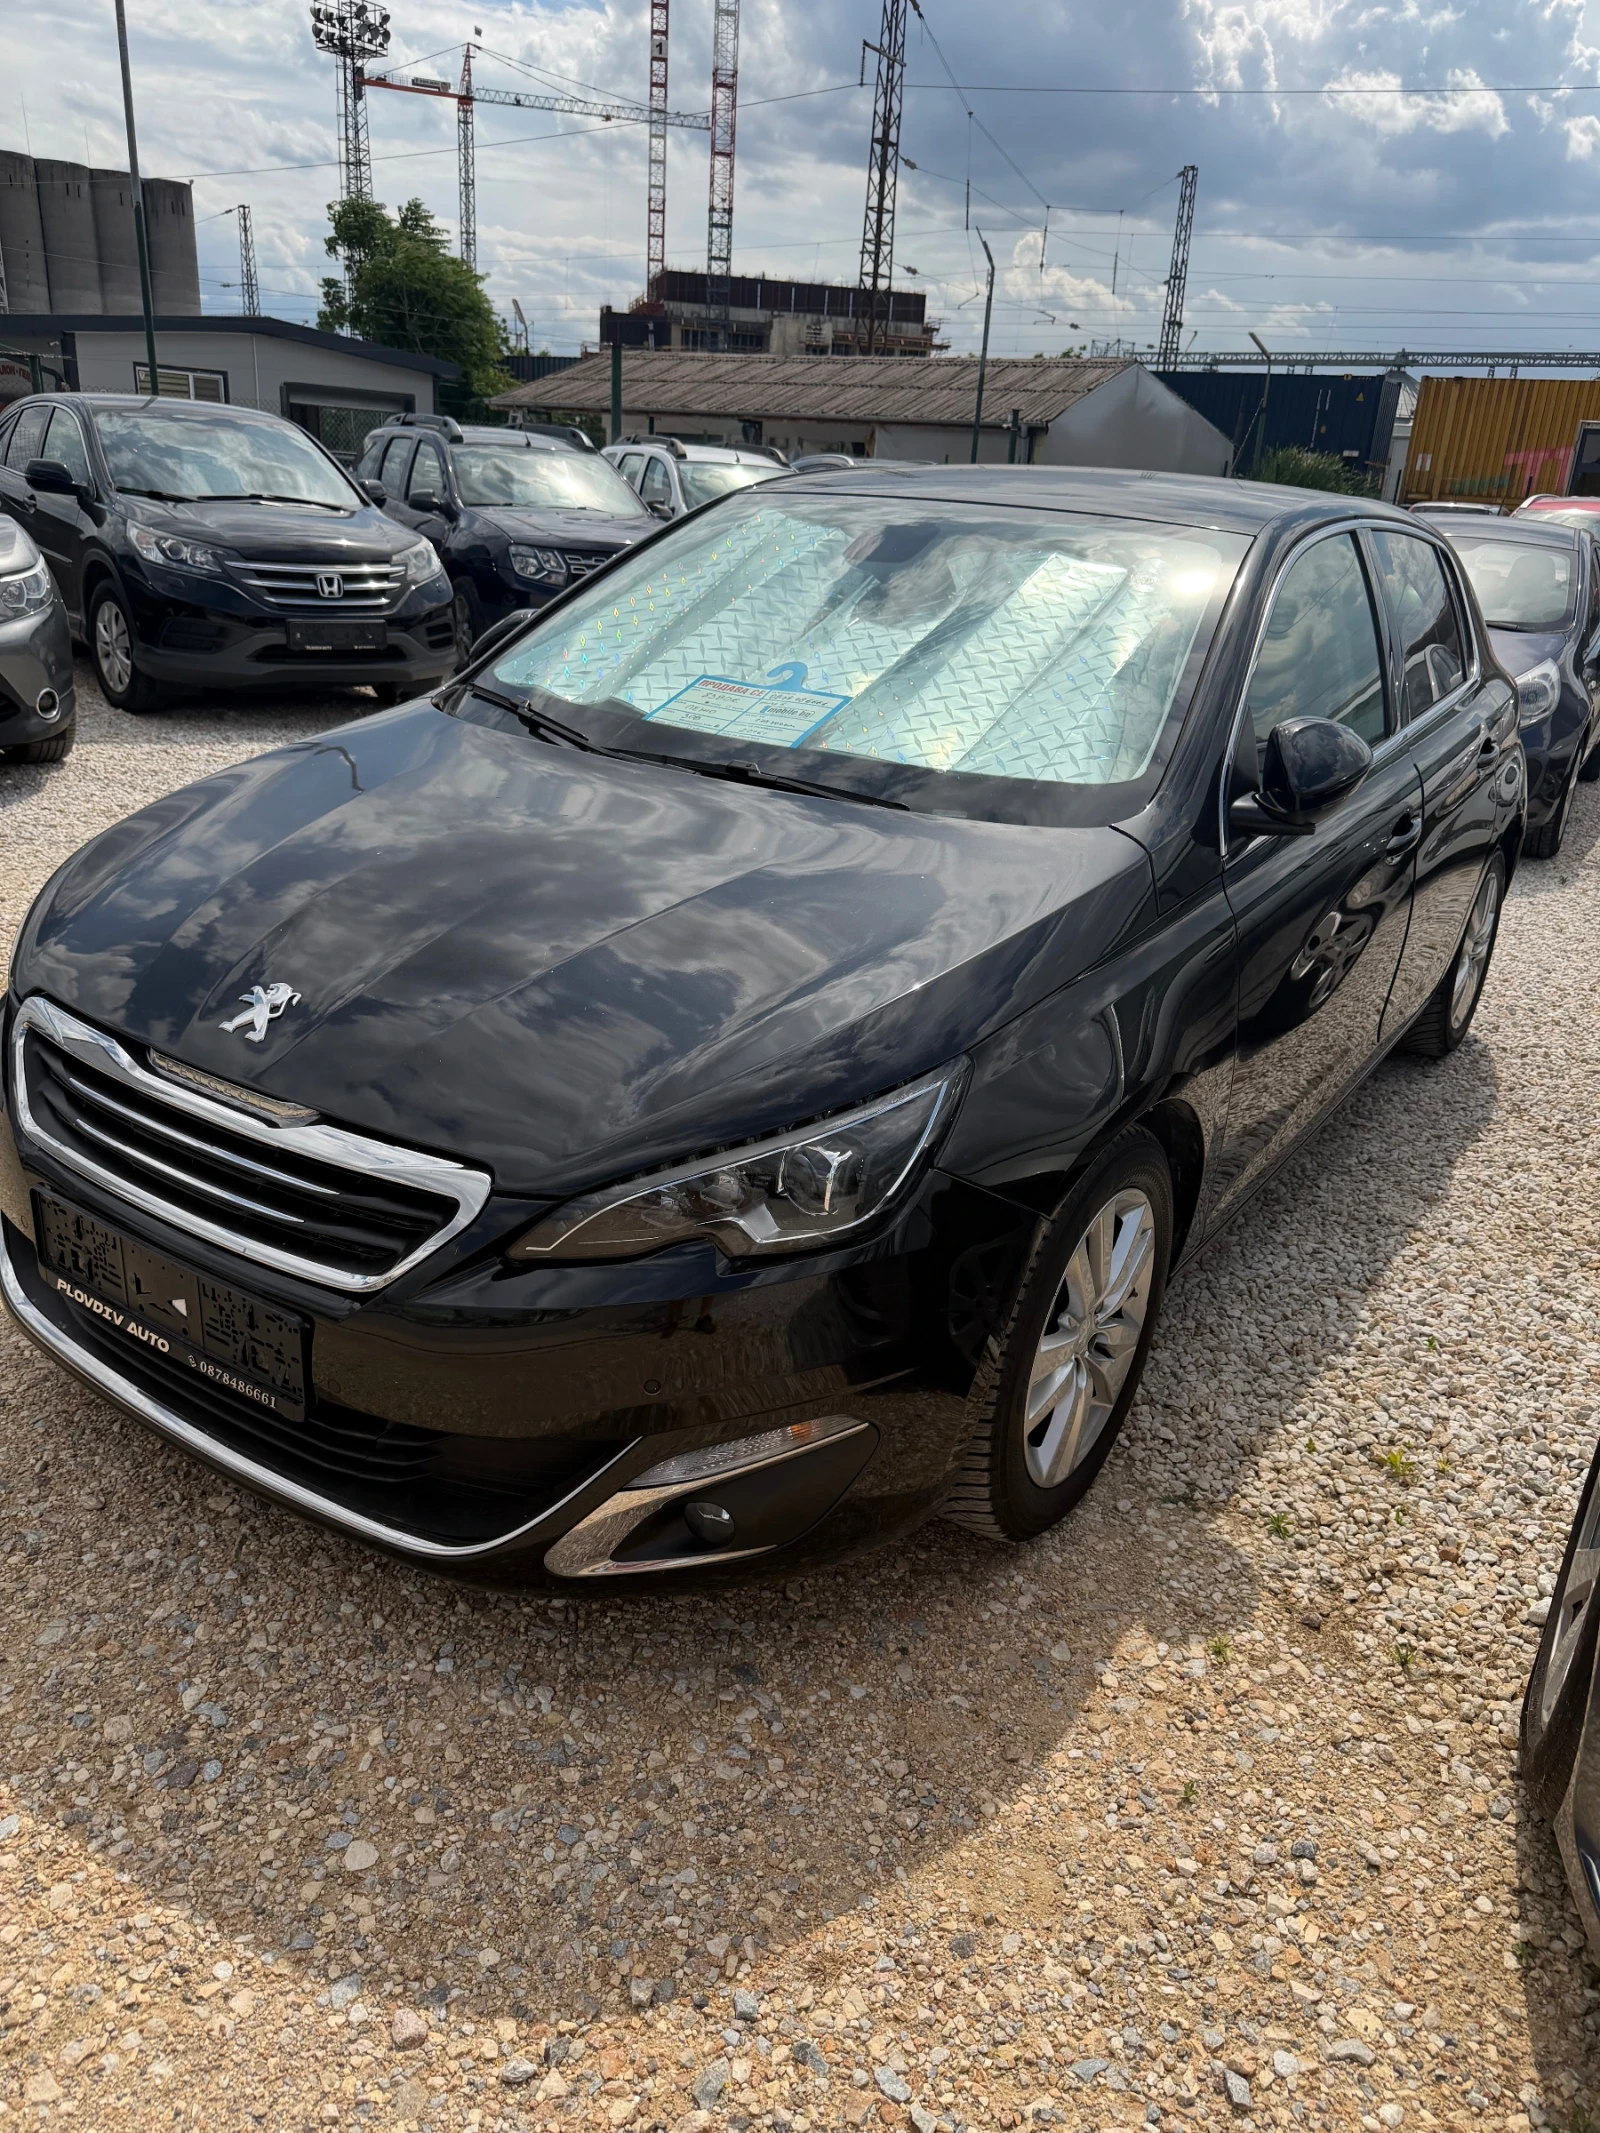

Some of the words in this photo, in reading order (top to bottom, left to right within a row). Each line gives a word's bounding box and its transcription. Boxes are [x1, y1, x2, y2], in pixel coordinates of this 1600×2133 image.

[655, 42, 663, 55] 1
[698, 680, 748, 695] ПРОДАВА
[749, 689, 766, 697] СЕ
[166, 1060, 263, 1108] PEUGEOT
[57, 1278, 124, 1326] PLOVDIV
[126, 1321, 170, 1353] AUTO
[200, 1361, 276, 1409] 0878486661
